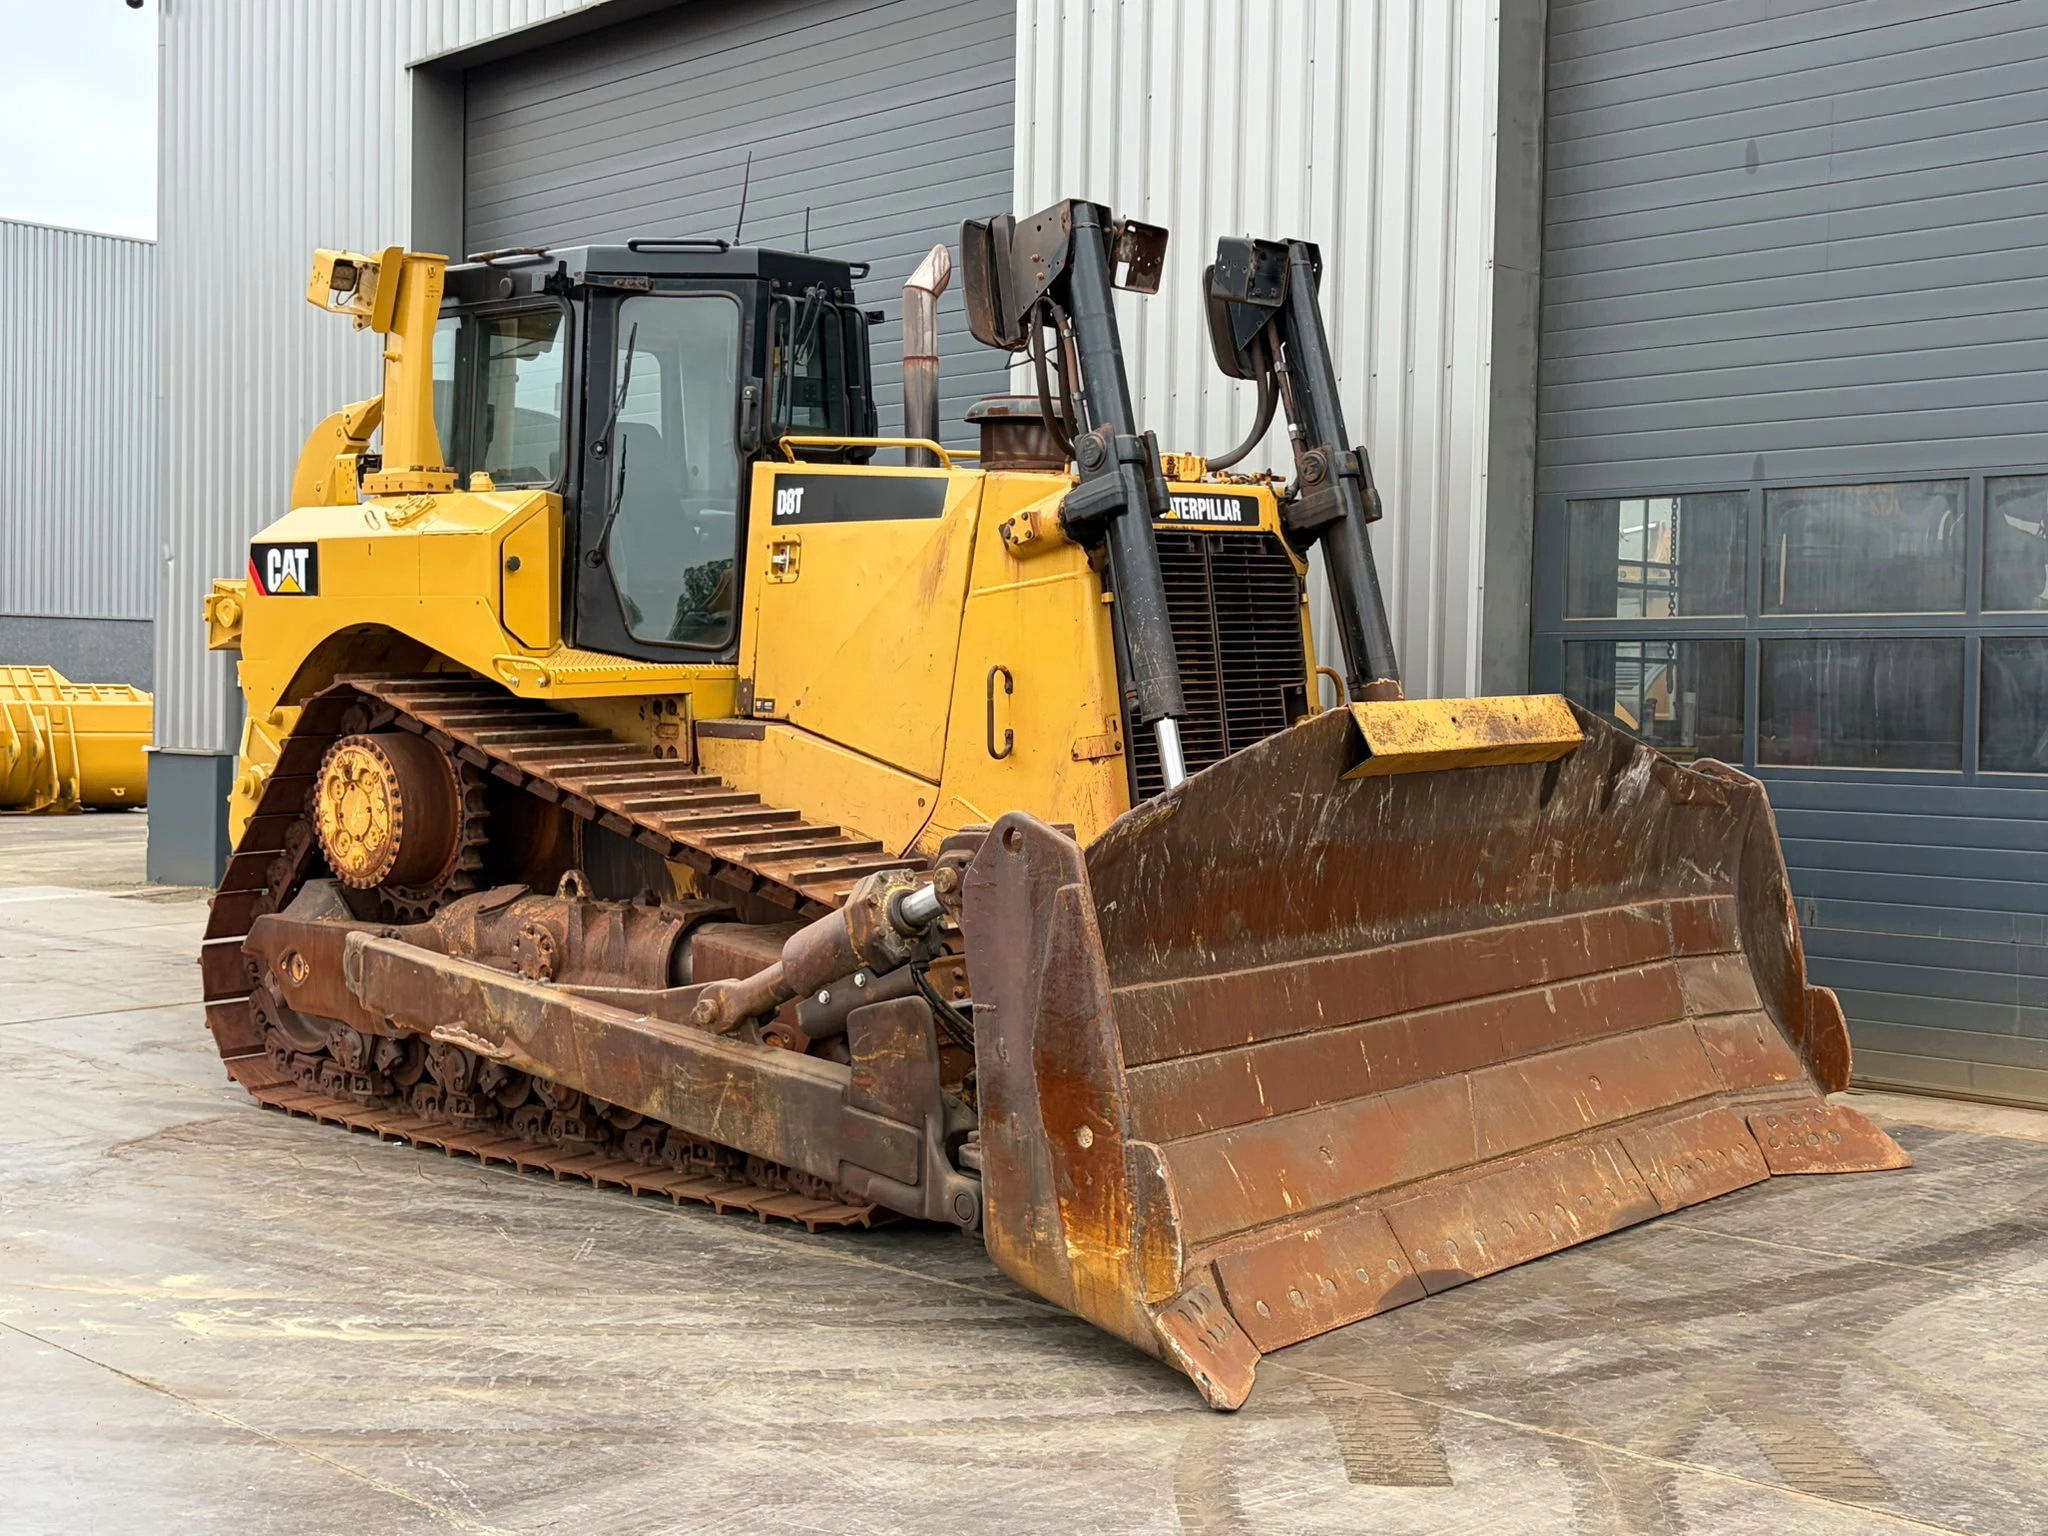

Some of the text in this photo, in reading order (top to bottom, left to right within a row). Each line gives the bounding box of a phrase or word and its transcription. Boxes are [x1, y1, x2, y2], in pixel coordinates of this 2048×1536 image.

[776, 487, 804, 515] D8T
[1159, 497, 1241, 521] TERPILLAR
[267, 548, 309, 593] CAT
